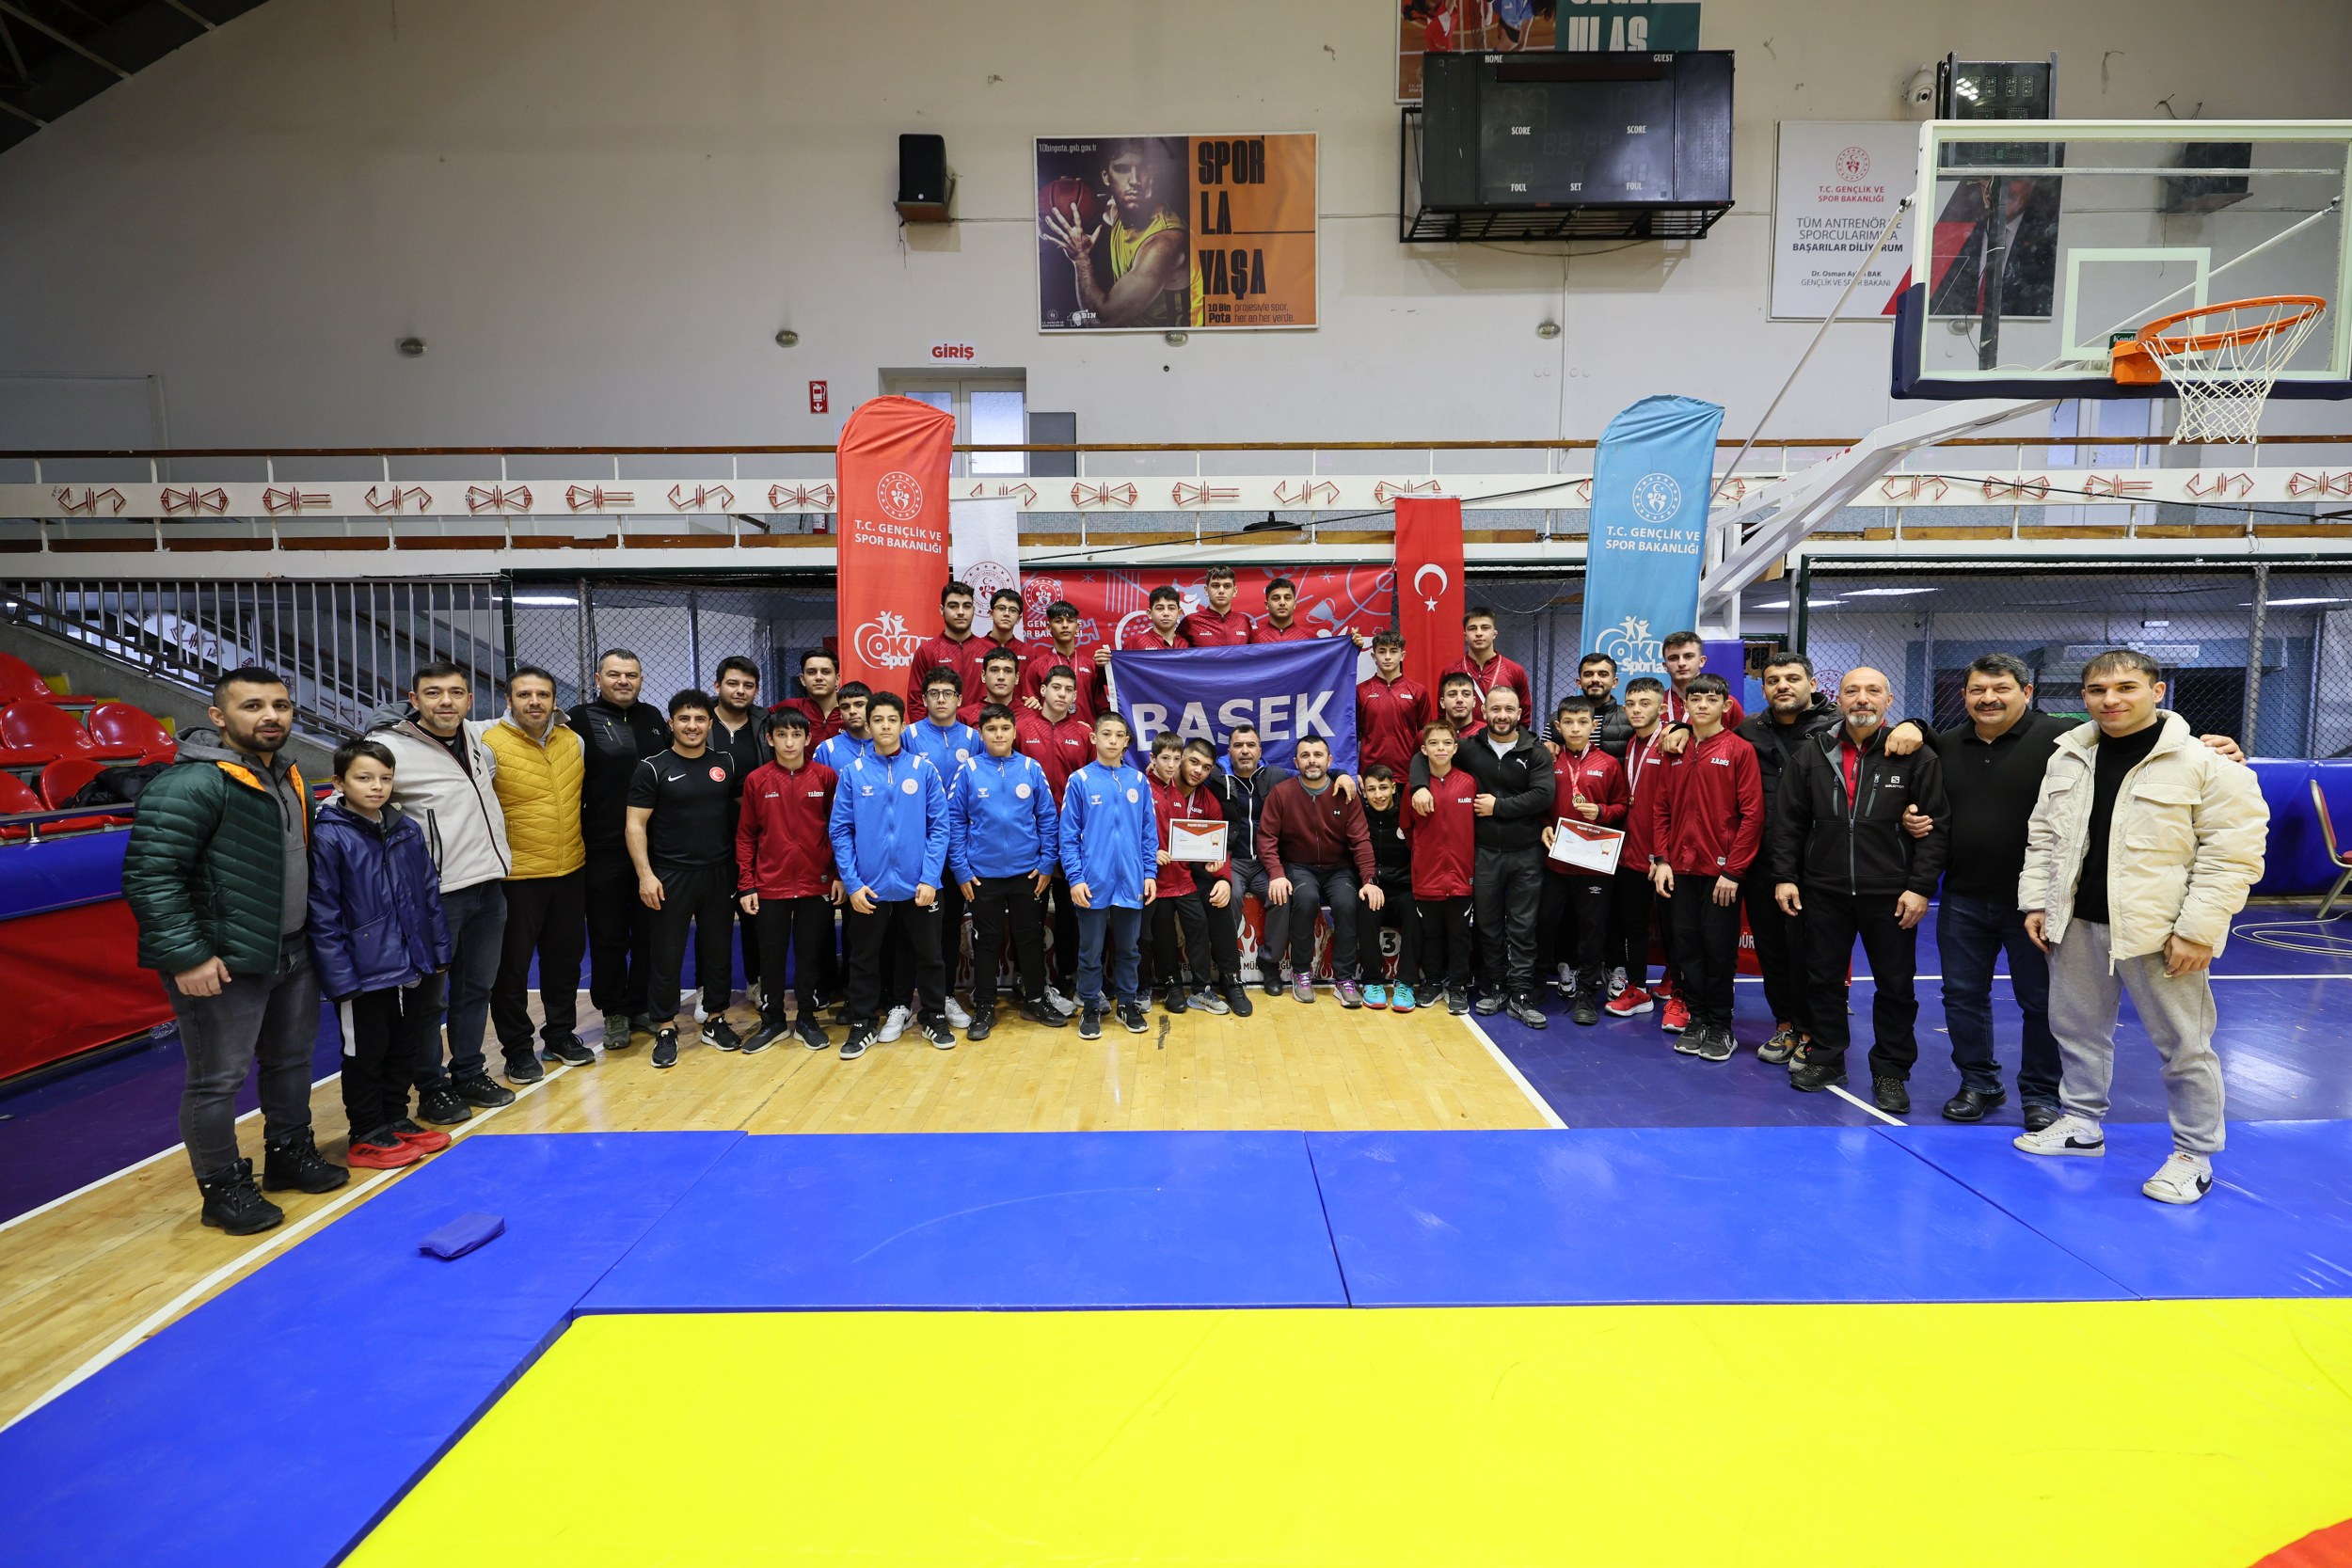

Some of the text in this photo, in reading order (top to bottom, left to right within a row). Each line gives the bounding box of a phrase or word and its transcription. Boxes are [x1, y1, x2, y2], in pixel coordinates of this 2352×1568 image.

[1485, 55, 1503, 63] HOME
[1653, 54, 1673, 62] GUEST
[1511, 126, 1531, 135] SCORE
[1627, 125, 1646, 134] SCORE
[1198, 139, 1265, 184] SPOR
[1511, 183, 1527, 192] FOUL
[1570, 182, 1582, 191] SET
[1626, 182, 1643, 190] FOUL
[1836, 185, 1871, 195] GENÇLİK
[1200, 191, 1232, 234] LA
[1796, 216, 1821, 228] TÜM
[1824, 216, 1886, 228] ANTRENÖR
[1792, 242, 1903, 253] BAŞARILAR DİLİYRUM
[1199, 249, 1266, 300] YAŞA
[1801, 278, 1832, 287] GENÇLİK
[1208, 303, 1232, 312] 10 Bin
[1234, 302, 1269, 312] projesiyle
[1208, 312, 1232, 323] Pota
[1234, 313, 1295, 323] her an her yerde.
[932, 343, 975, 360] GİRİŞ
[854, 519, 942, 541] T.C. GENÇLİK VE
[1606, 526, 1700, 542] T.C. GENÇLİK VE
[854, 533, 942, 554] SPOR BAKANLIĞI
[1606, 539, 1699, 555] SPOR BAKANLIĞI
[1383, 932, 1397, 954] 3
